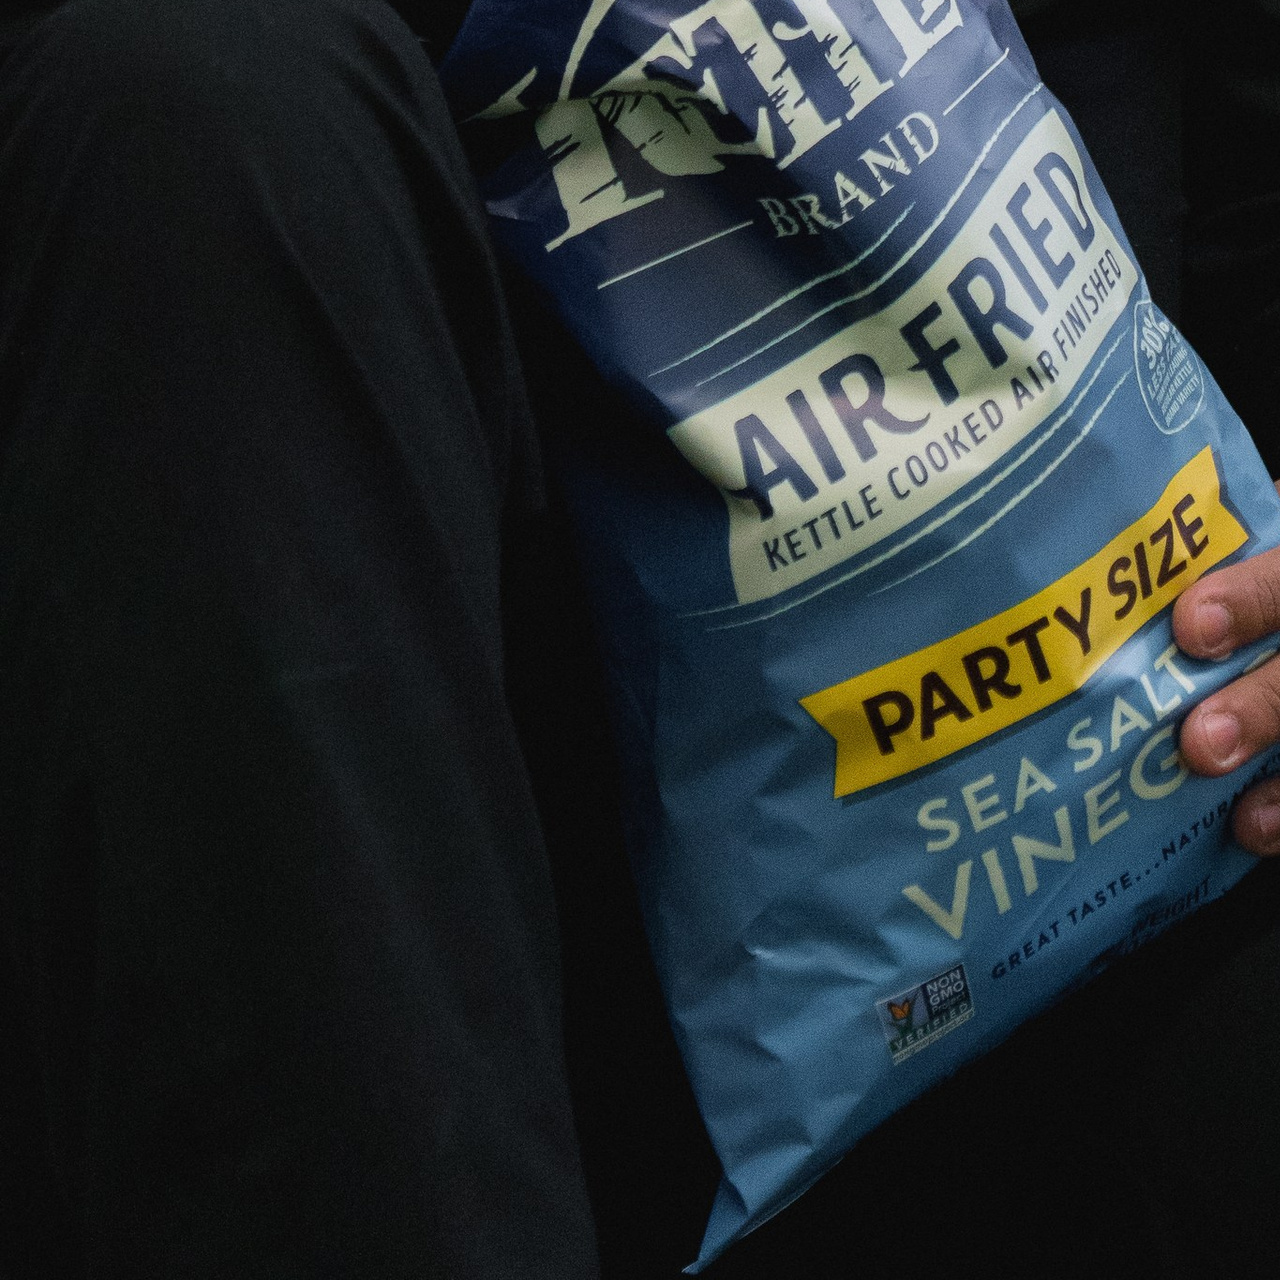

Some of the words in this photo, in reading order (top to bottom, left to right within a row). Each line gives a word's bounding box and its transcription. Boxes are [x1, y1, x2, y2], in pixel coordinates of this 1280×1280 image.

[758, 111, 940, 239] BRAND
[720, 352, 932, 521] AIR
[900, 150, 1097, 407] FRIED
[1141, 306, 1170, 370] 30%
[762, 485, 883, 572] KETTLE
[887, 398, 1005, 502] COOKED
[1010, 355, 1058, 412] AIR
[1057, 248, 1123, 361] FINISHED
[1147, 356, 1166, 400] LESS
[1176, 373, 1200, 406] VARIETY
[861, 587, 1094, 757] PARTY
[1106, 493, 1210, 622] SIZE
[902, 725, 1193, 941] VINEG
[916, 756, 1058, 854] SEA
[926, 969, 961, 996] NON
[990, 921, 1061, 981] GREAT
[929, 980, 965, 1006] GMO
[894, 1002, 969, 1052] VERIFIED
